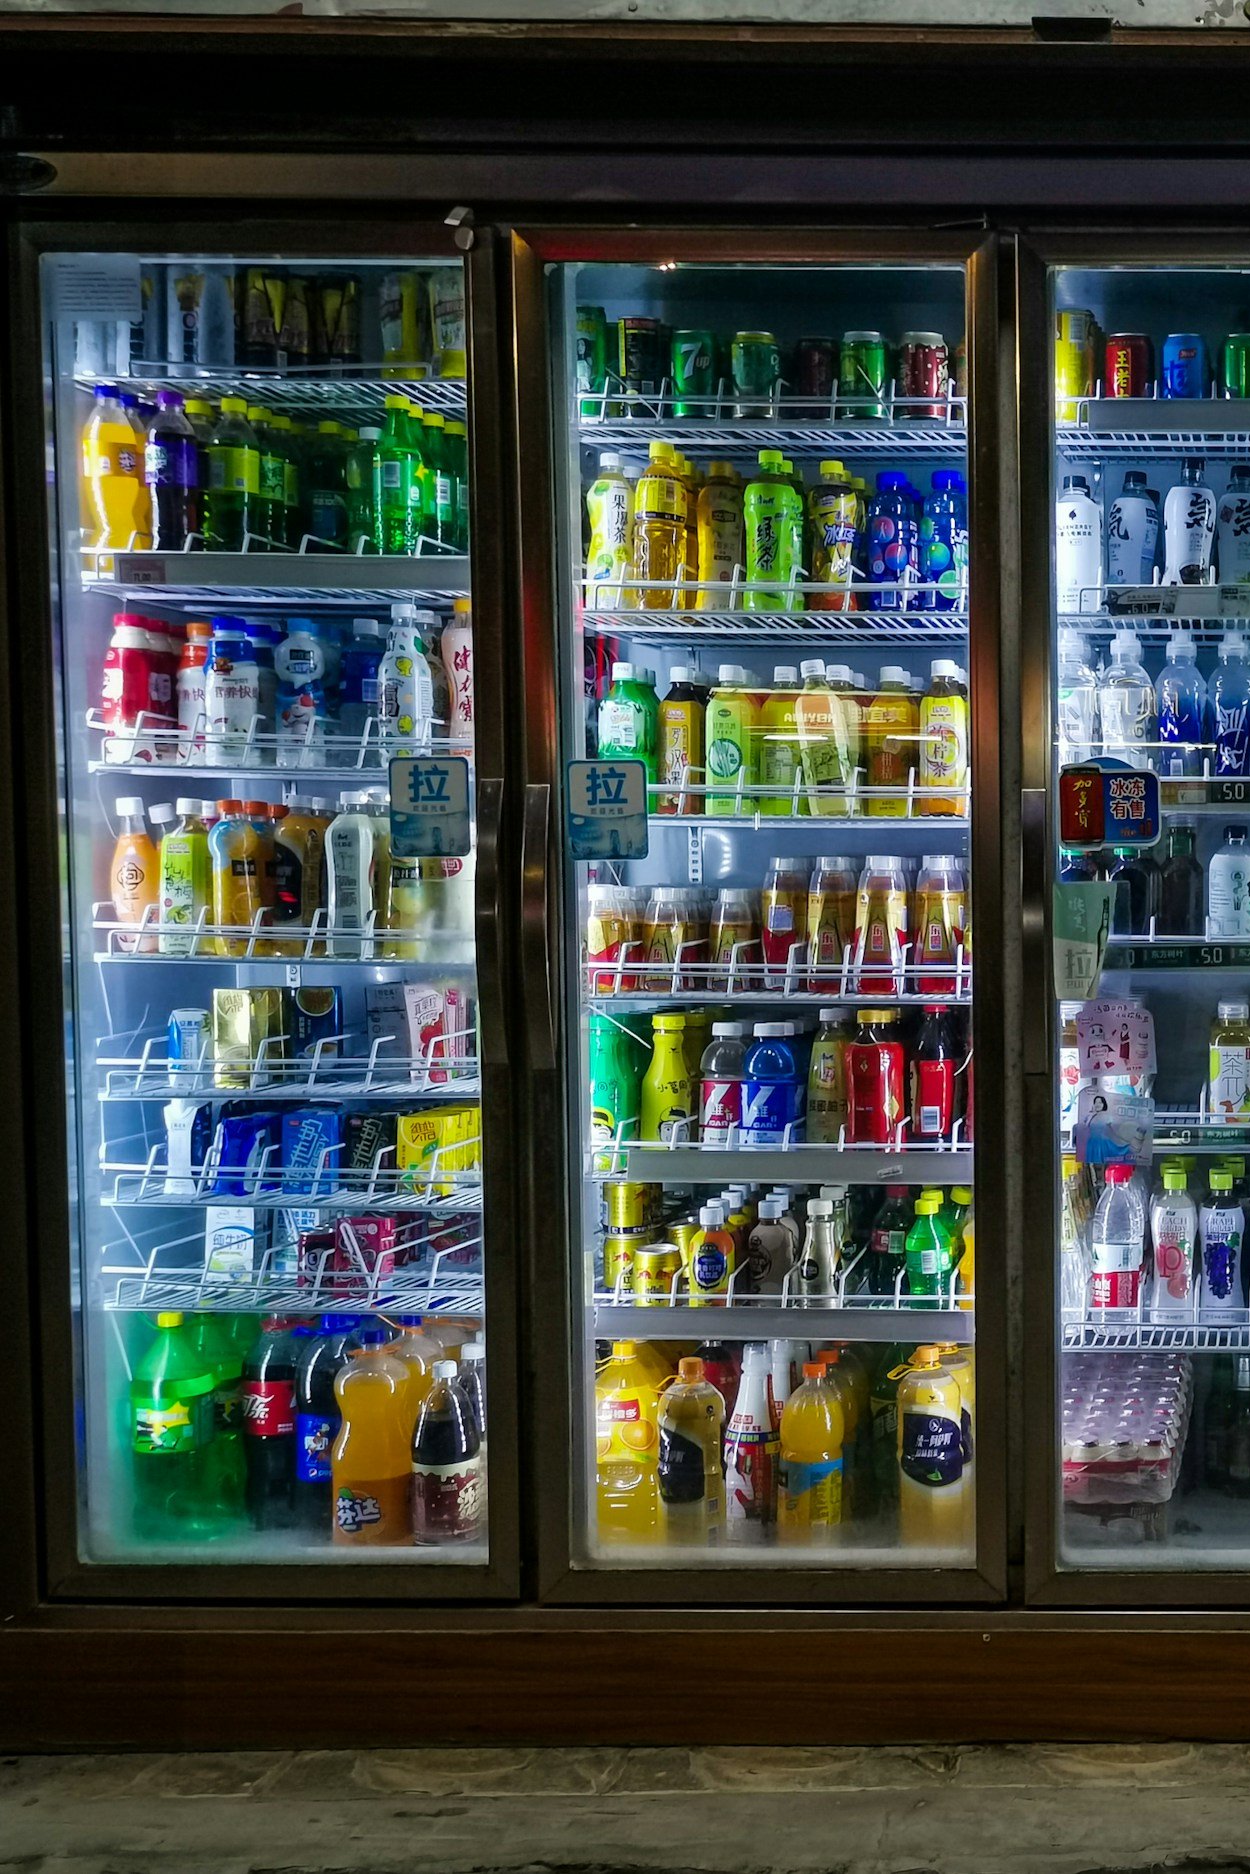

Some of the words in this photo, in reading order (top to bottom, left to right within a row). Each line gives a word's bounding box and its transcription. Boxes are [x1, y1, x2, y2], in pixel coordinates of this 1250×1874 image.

[408, 764, 451, 802] 拉
[586, 767, 628, 806] 拉
[1109, 778, 1146, 798] 冰冻
[1110, 798, 1146, 820] 有售
[1064, 948, 1093, 979] 拉
[336, 1497, 381, 1525] 芬达
